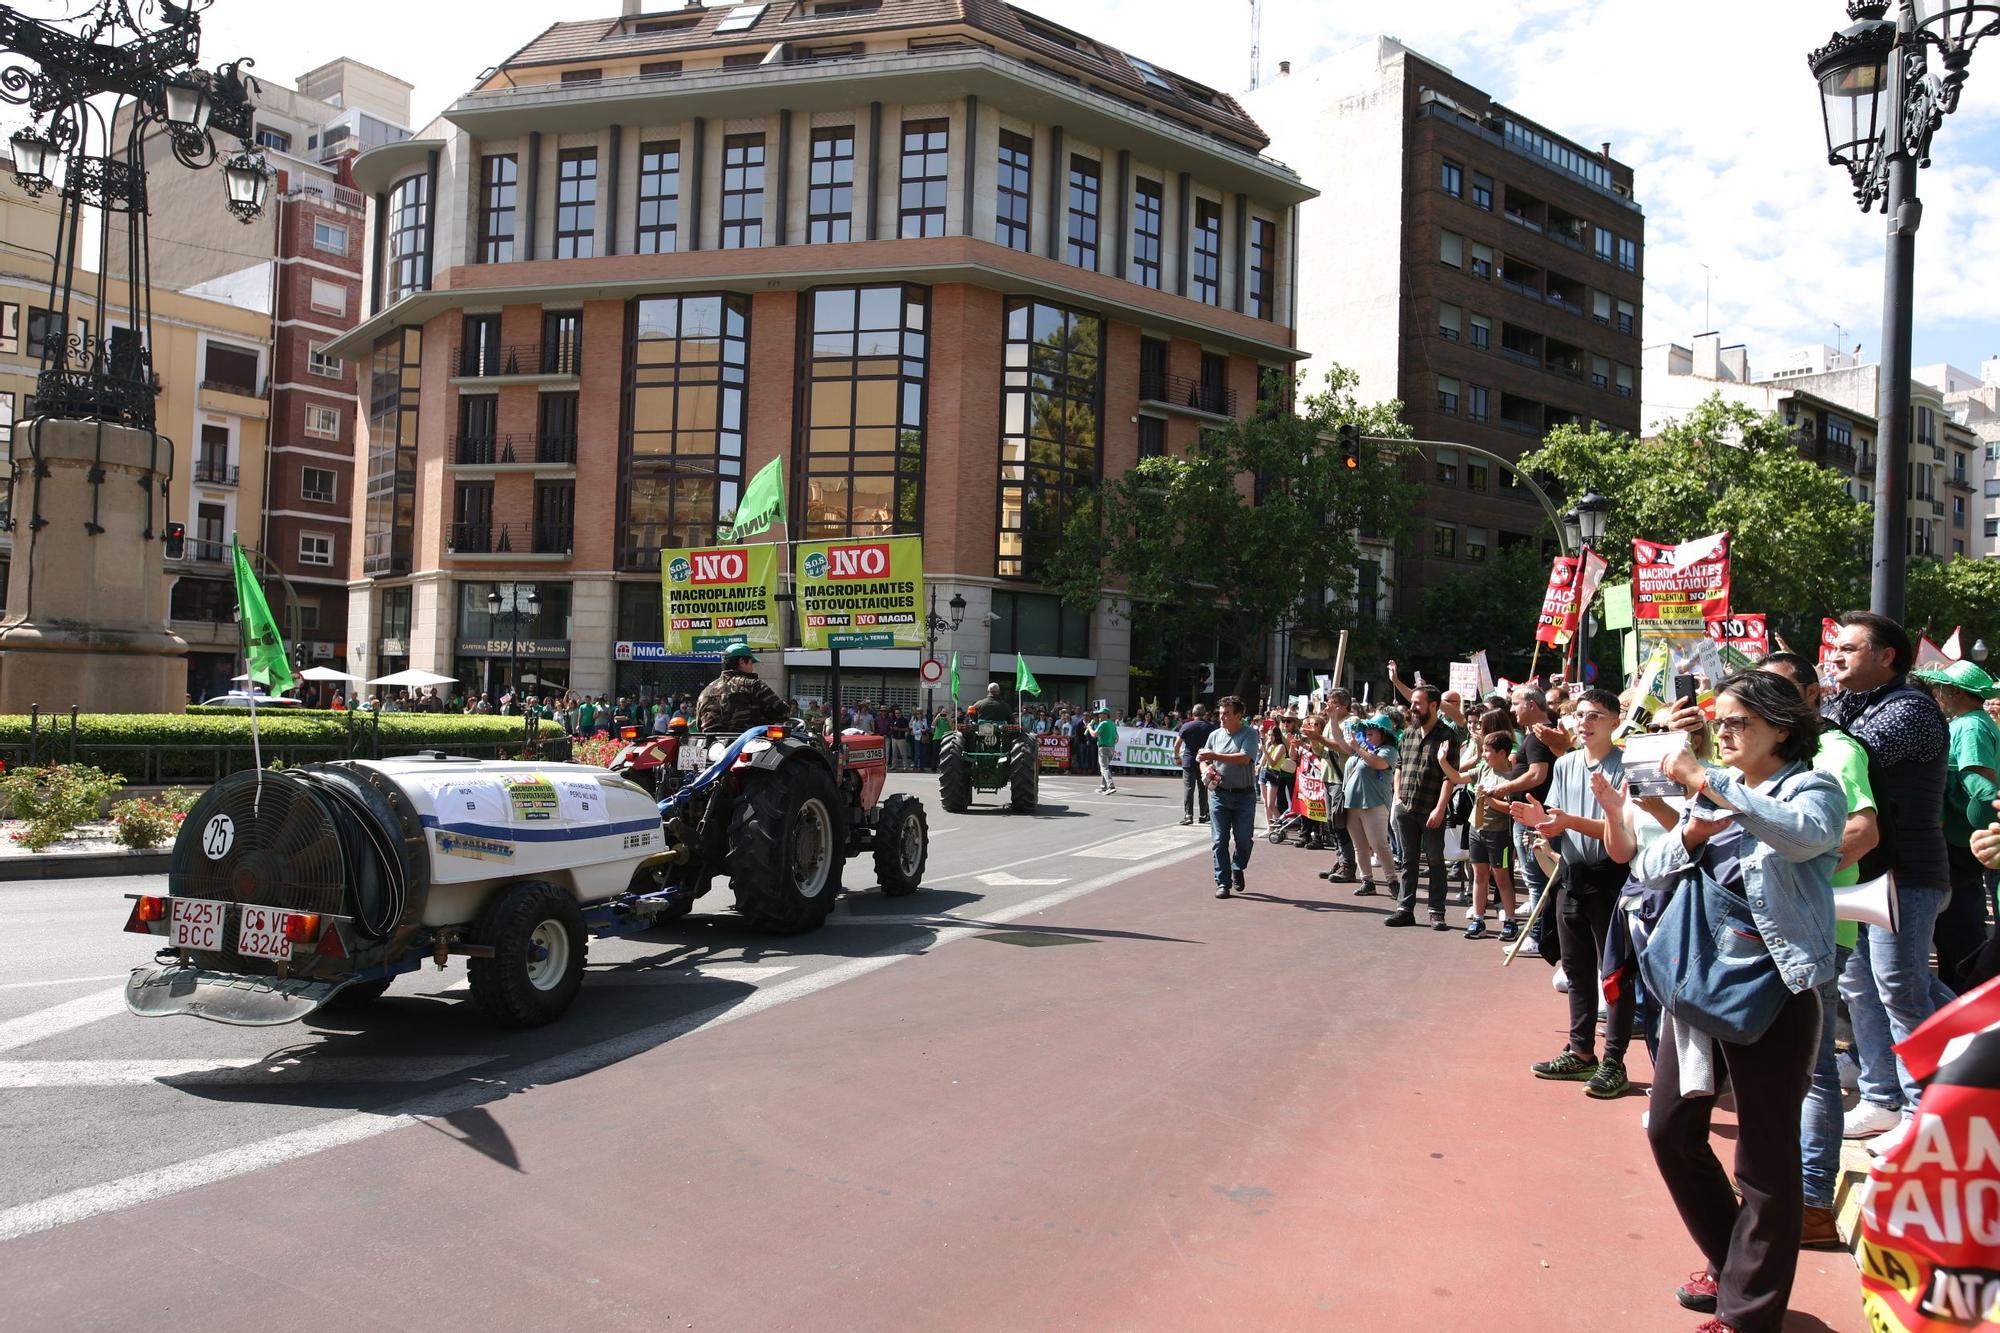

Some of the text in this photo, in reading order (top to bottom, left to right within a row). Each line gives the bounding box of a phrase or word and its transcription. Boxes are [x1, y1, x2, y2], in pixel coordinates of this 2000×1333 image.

[695, 554, 743, 580] NO
[832, 548, 885, 575] NO
[805, 582, 914, 597] MACROPLANTES
[1640, 576, 1722, 591] FOTOVOLTAIQUES
[670, 586, 766, 601] MACROPLANTES
[1639, 594, 1653, 602] NO
[1654, 593, 1685, 601] VALENTIA
[1689, 592, 1706, 601] NO
[671, 600, 766, 614] FOTOVOLTAIQUES
[806, 596, 914, 611] FOTOVOLTAIQUES
[672, 617, 767, 629] NO MAT NO MAGDA
[808, 614, 914, 626] NO MAT NO MAGDA
[1044, 738, 1059, 746] NO
[1129, 747, 1162, 764] MÓN
[511, 792, 556, 800] FOTOVOLTAIQUES
[208, 818, 230, 855] 25
[173, 901, 222, 926] E4251
[178, 924, 214, 947] BCC
[239, 931, 290, 957] 43248
